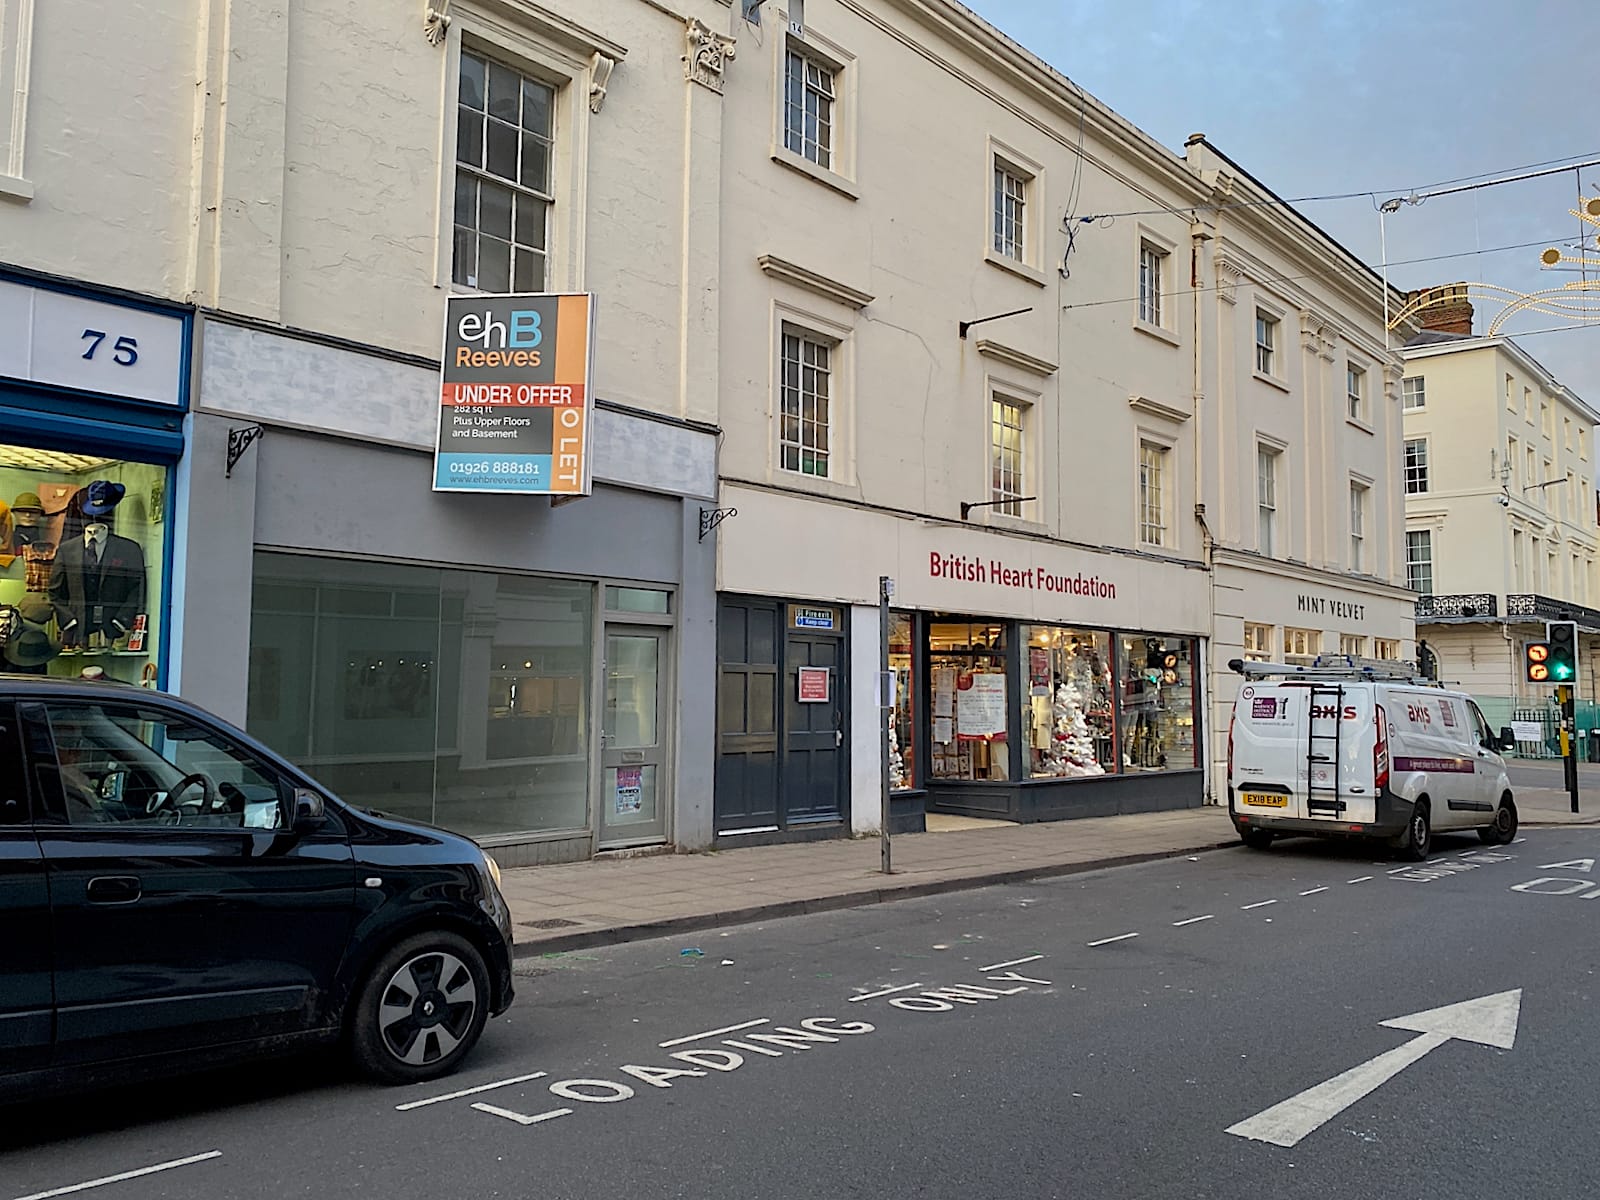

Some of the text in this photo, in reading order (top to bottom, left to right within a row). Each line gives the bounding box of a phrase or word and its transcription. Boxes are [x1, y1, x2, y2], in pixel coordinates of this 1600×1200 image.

[792, 22, 802, 34] 14
[458, 310, 542, 348] ehB
[81, 328, 138, 367] 75
[455, 346, 541, 367] Reeves
[454, 385, 572, 404] UNDER OFFER
[453, 417, 531, 427] Plus Upper Floors
[560, 408, 579, 428] O
[452, 428, 518, 439] and Basement
[450, 462, 540, 475] 01926 888181
[558, 437, 578, 486] LET
[449, 475, 539, 485] www.ehbreeves.com
[929, 551, 1117, 600] British Heart Foundation
[1297, 594, 1365, 621] MINT VELVET
[1407, 700, 1431, 728] axis
[1266, 795, 1283, 805] EAP
[471, 970, 1053, 1126] LOADING ONLY
